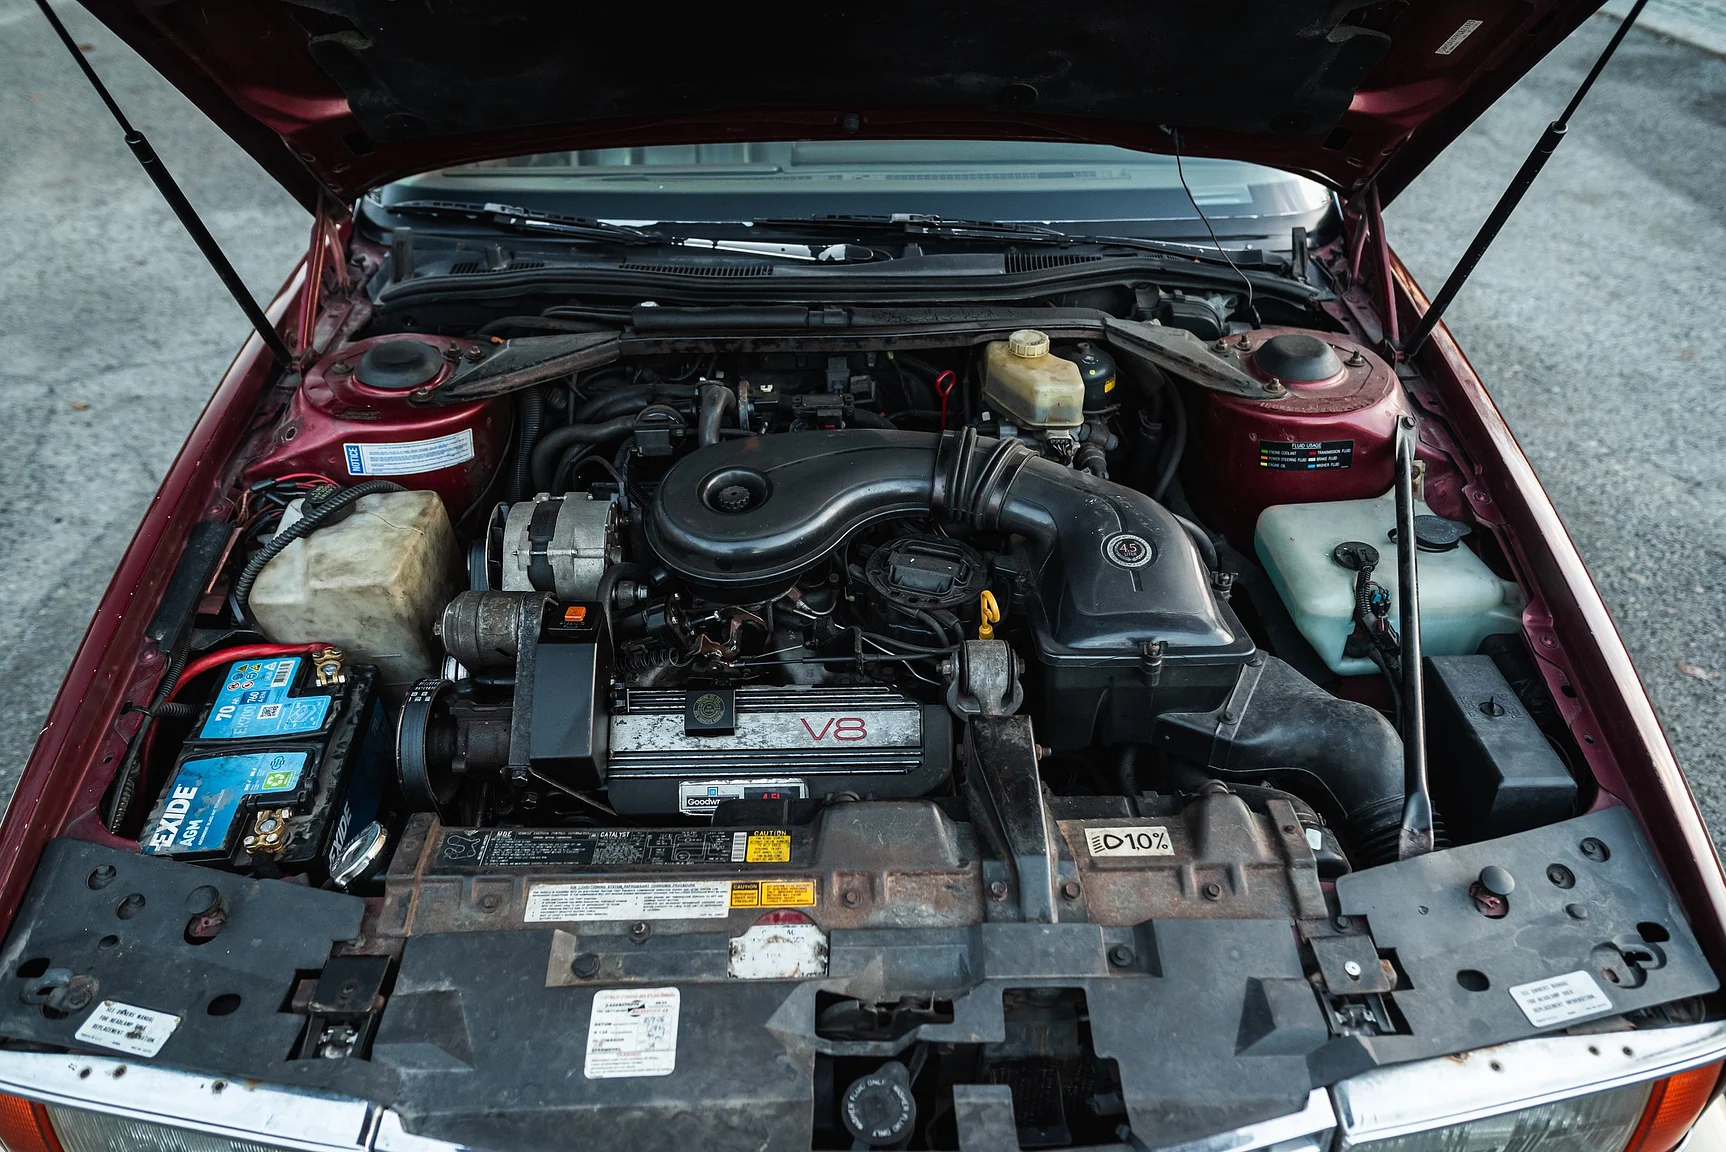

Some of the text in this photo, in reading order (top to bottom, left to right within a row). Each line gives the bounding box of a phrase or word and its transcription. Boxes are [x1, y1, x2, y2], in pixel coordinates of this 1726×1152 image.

[348, 447, 361, 472] NOTICE
[1119, 543, 1137, 552] 4.5
[247, 691, 259, 703] 760
[215, 705, 236, 722] 70
[234, 705, 257, 734] EK700
[800, 717, 868, 741] V8
[149, 784, 199, 851] EXIDE
[180, 819, 203, 847] AGM
[329, 801, 352, 863] EXIDE
[92, 1023, 124, 1036] REPLACEMENT
[110, 1017, 134, 1027] HEADLAMP
[867, 1079, 885, 1087] ONLY
[871, 1127, 891, 1137] ONLY
